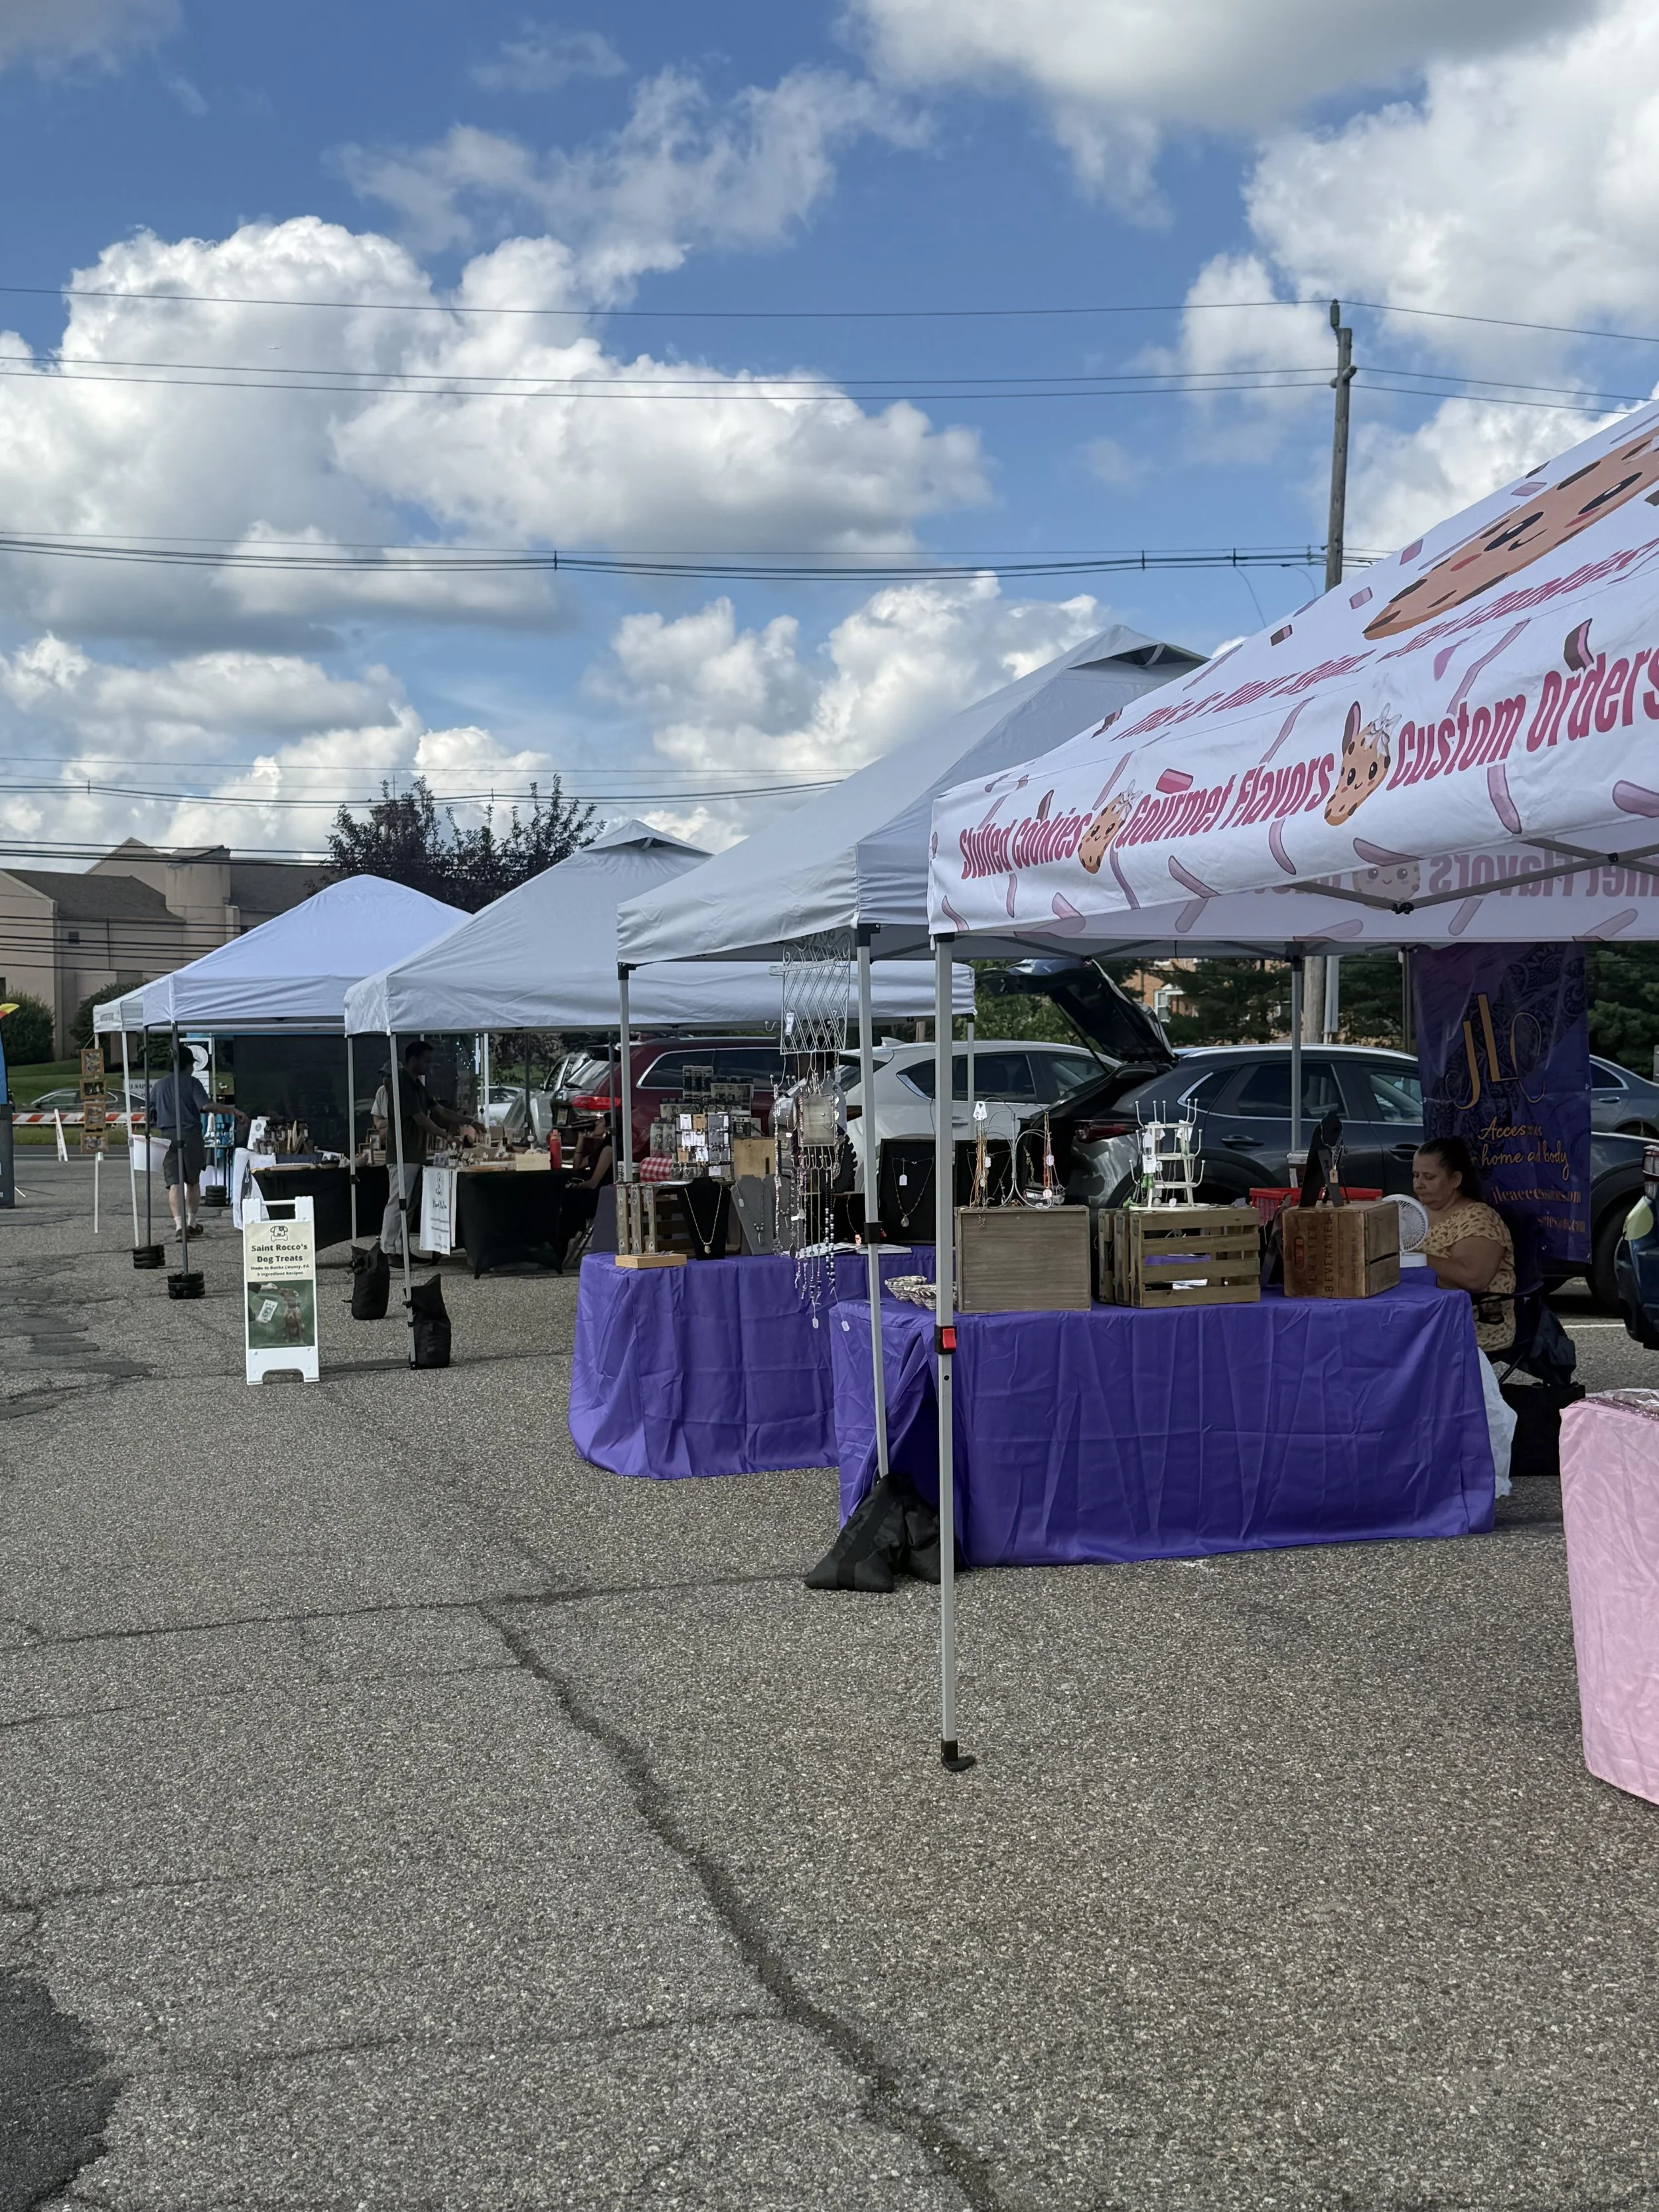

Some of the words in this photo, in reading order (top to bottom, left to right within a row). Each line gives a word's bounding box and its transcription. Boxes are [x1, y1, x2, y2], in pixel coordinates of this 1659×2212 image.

[960, 819, 1018, 879] Stuffed
[1012, 807, 1093, 869] Cookies
[1115, 774, 1237, 849] Gourmet
[1218, 753, 1334, 830] Flavors
[1386, 694, 1526, 791] Custom
[1526, 647, 1659, 752] Orders
[1481, 1143, 1524, 1166] home
[1542, 1140, 1571, 1181] body
